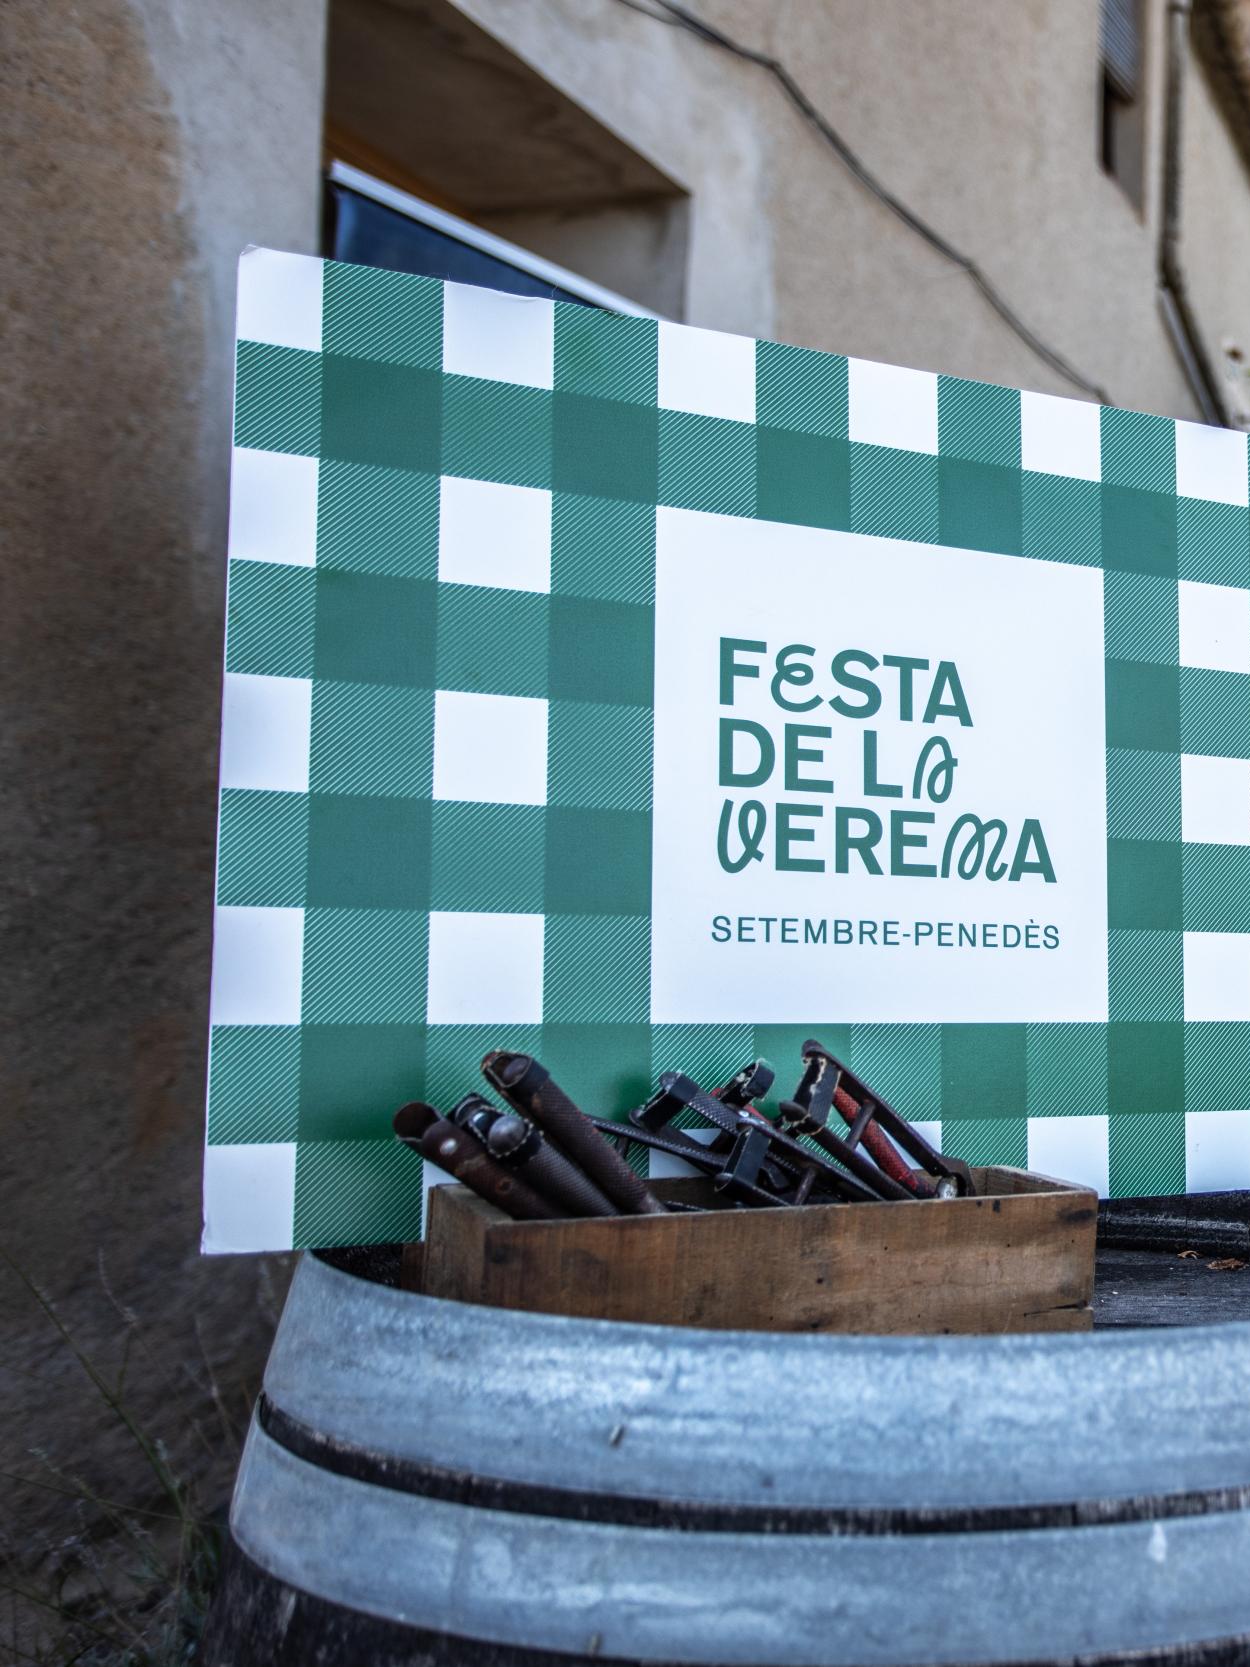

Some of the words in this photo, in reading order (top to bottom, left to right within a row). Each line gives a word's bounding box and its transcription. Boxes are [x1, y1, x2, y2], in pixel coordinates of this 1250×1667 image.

[719, 636, 974, 728] FESTA
[718, 717, 834, 794] DE
[863, 729, 958, 804] LA
[717, 798, 1058, 884] VEREMA
[711, 915, 1060, 950] SETEMBRE-PENEDÈS
